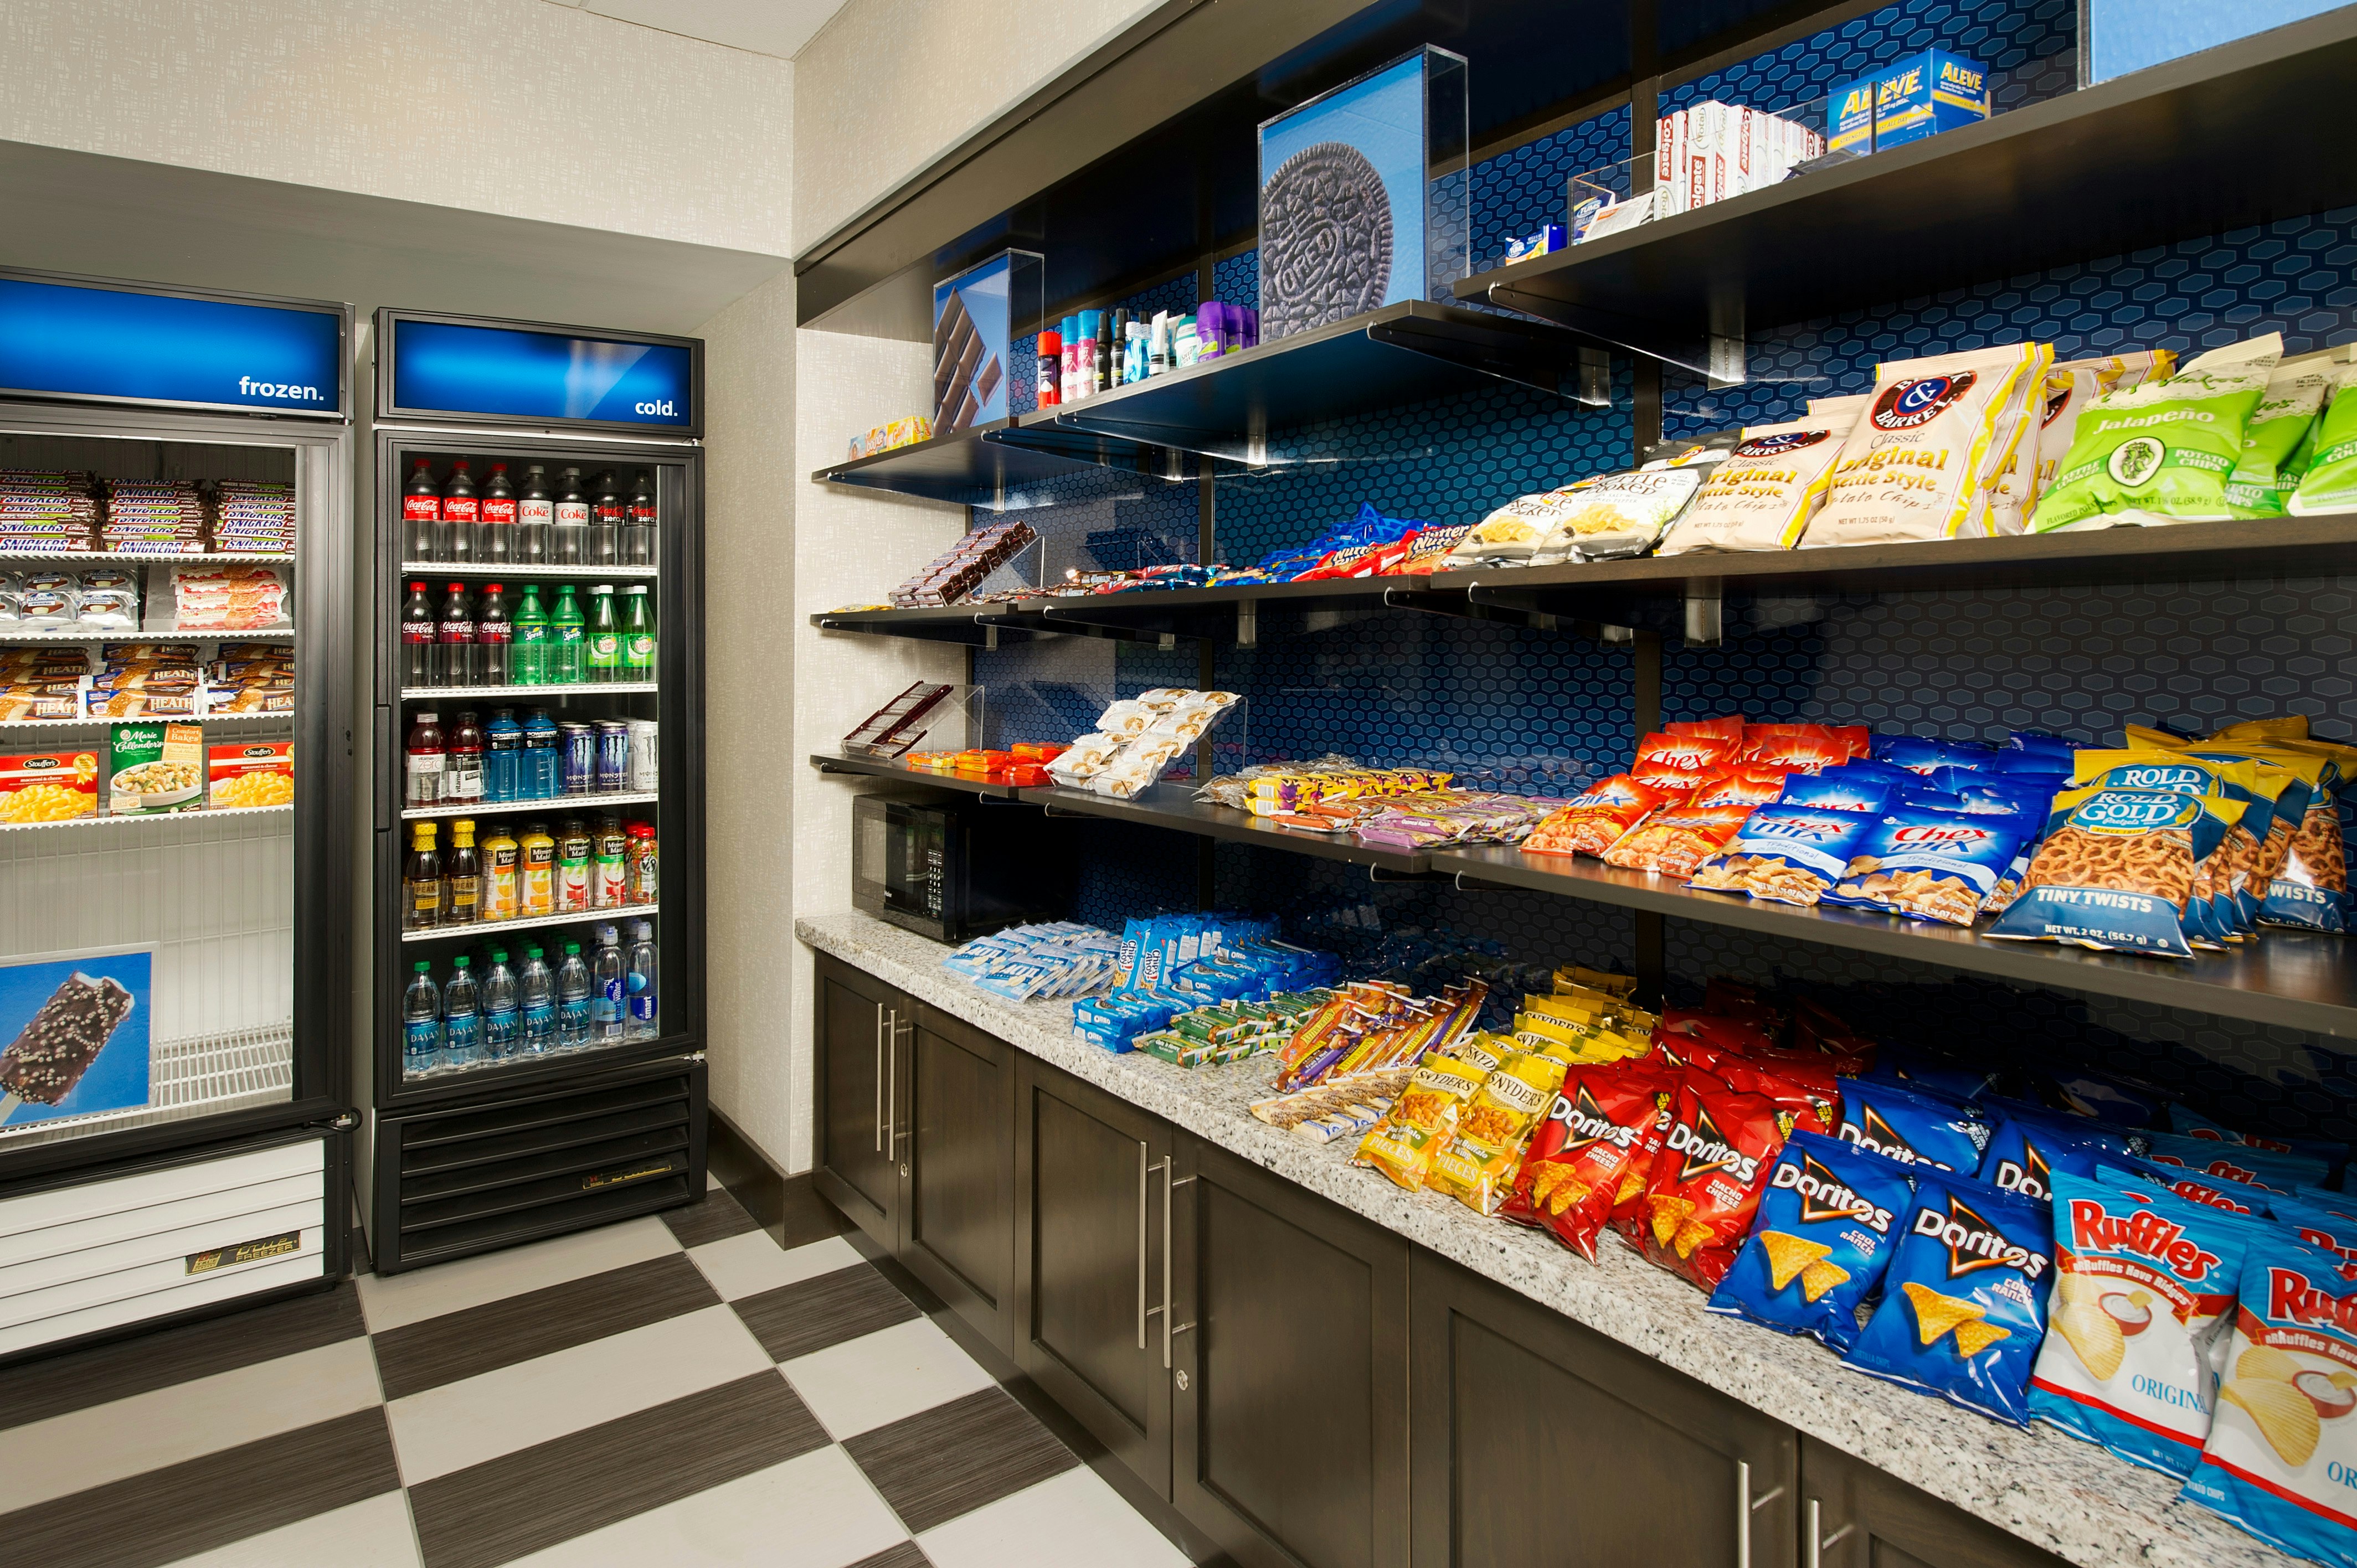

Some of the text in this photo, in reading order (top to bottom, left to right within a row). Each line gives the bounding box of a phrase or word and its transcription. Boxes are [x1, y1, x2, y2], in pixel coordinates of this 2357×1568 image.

[1940, 61, 1983, 90] ALEVE
[1662, 118, 1673, 178] Colgate
[1741, 111, 1752, 169] Colgate
[1692, 158, 1705, 210] olgate
[1579, 202, 1601, 214] TUMS
[1509, 245, 1525, 255] TUMS
[239, 376, 325, 401] frozen.
[1906, 382, 1937, 408] &
[635, 399, 678, 416] cold.
[1875, 396, 1953, 428] BARREL
[2092, 407, 2215, 436] Jalapeño
[1870, 430, 1926, 451] Classic
[1727, 457, 1780, 469] Classic
[1835, 446, 1949, 475] Original
[2174, 448, 2230, 468] POTATO
[2178, 456, 2223, 473] CHIPS
[1707, 468, 1798, 486] riginal
[2055, 466, 2101, 491] COOKED
[2061, 460, 2101, 482] KETTLE
[1882, 470, 1937, 492] Style
[116, 488, 175, 497] SNICKERS
[1737, 485, 1784, 499] Style
[2170, 496, 2183, 505] OZ.
[2184, 496, 2203, 506] (38.9
[406, 499, 438, 512] Coca-Cola
[446, 501, 477, 513] Coca-Cola
[485, 503, 515, 515] Coca-Cola
[522, 506, 549, 517] Coke
[560, 508, 587, 520] Coke
[1879, 515, 1888, 524] (50
[1888, 515, 1896, 525] g)
[2047, 509, 2077, 525] FLAVORED
[525, 630, 544, 642] Sprite
[563, 630, 581, 642] Sprite
[43, 666, 86, 675] HEATH
[150, 697, 193, 711] HEATH
[129, 730, 157, 743] Marie
[171, 734, 199, 743] Bakes
[113, 740, 164, 753] Callender's
[247, 748, 271, 757] Stouffer's
[27, 759, 56, 769] Stouffer's
[418, 760, 442, 770] zero
[1647, 749, 1713, 771] Chex
[2122, 768, 2201, 787] ROLD
[2094, 792, 2179, 804] ROLD
[2078, 803, 2176, 822] GOLD
[2102, 817, 2139, 826] Pretzels
[1750, 822, 1825, 843] mix
[1760, 816, 1858, 833] Chex
[1894, 826, 1989, 842] Chex
[1766, 841, 1819, 860] Traditional
[1886, 838, 1973, 854] mix
[641, 858, 657, 872] V8
[1907, 855, 1968, 869] Traditional
[2036, 888, 2153, 914] TINY TWISTS
[2269, 884, 2327, 904] WISTS
[1912, 902, 1951, 917] WT 1.75 OZ
[2044, 924, 2148, 946] NET WT. 2 OZ. (56.7 g)
[1120, 941, 1133, 970] Ahoy!
[1126, 940, 1136, 965] Chips
[1151, 948, 1161, 975] Chips
[1231, 951, 1247, 961] OREO
[1145, 950, 1159, 981] Ahoy!
[1191, 990, 1214, 1002] OREO
[1195, 982, 1211, 991] OREO
[487, 1019, 517, 1032] DASANI
[1094, 1014, 1111, 1025] OREO
[1087, 1031, 1103, 1042] OREO
[1340, 1038, 1375, 1071] NATURE VALLEY
[1416, 1070, 1474, 1091] SNYDER'S
[1488, 1073, 1545, 1106] SNYDER'S
[1550, 1096, 1642, 1148] Doritos
[1368, 1137, 1413, 1162] PIECES
[1452, 1137, 1489, 1159] Hot Buffalo
[1454, 1147, 1471, 1161] Wing
[1666, 1122, 1759, 1182] Doritos
[1437, 1156, 1479, 1183] PIECES
[1586, 1152, 1616, 1170] CHEESE
[1705, 1184, 1741, 1210] CHEESE
[1772, 1163, 1894, 1234] Doritos
[1839, 1230, 1875, 1256] RANCH
[1850, 1229, 1877, 1250] COOL
[1915, 1210, 2050, 1280] Doritos
[2068, 1199, 2222, 1283] Ruffles
[236, 1244, 293, 1262] FREEZER
[2003, 1277, 2034, 1297] COOL
[2072, 1257, 2190, 1307] RRRuffles Have Ridges
[1991, 1282, 2034, 1306] RANCH
[2265, 1332, 2325, 1352] RRRuffles
[1852, 1348, 1891, 1369] TORTILLA CHIPS
[2132, 1373, 2211, 1416] ORIGINAL
[2206, 1487, 2225, 1502] CHIPS
